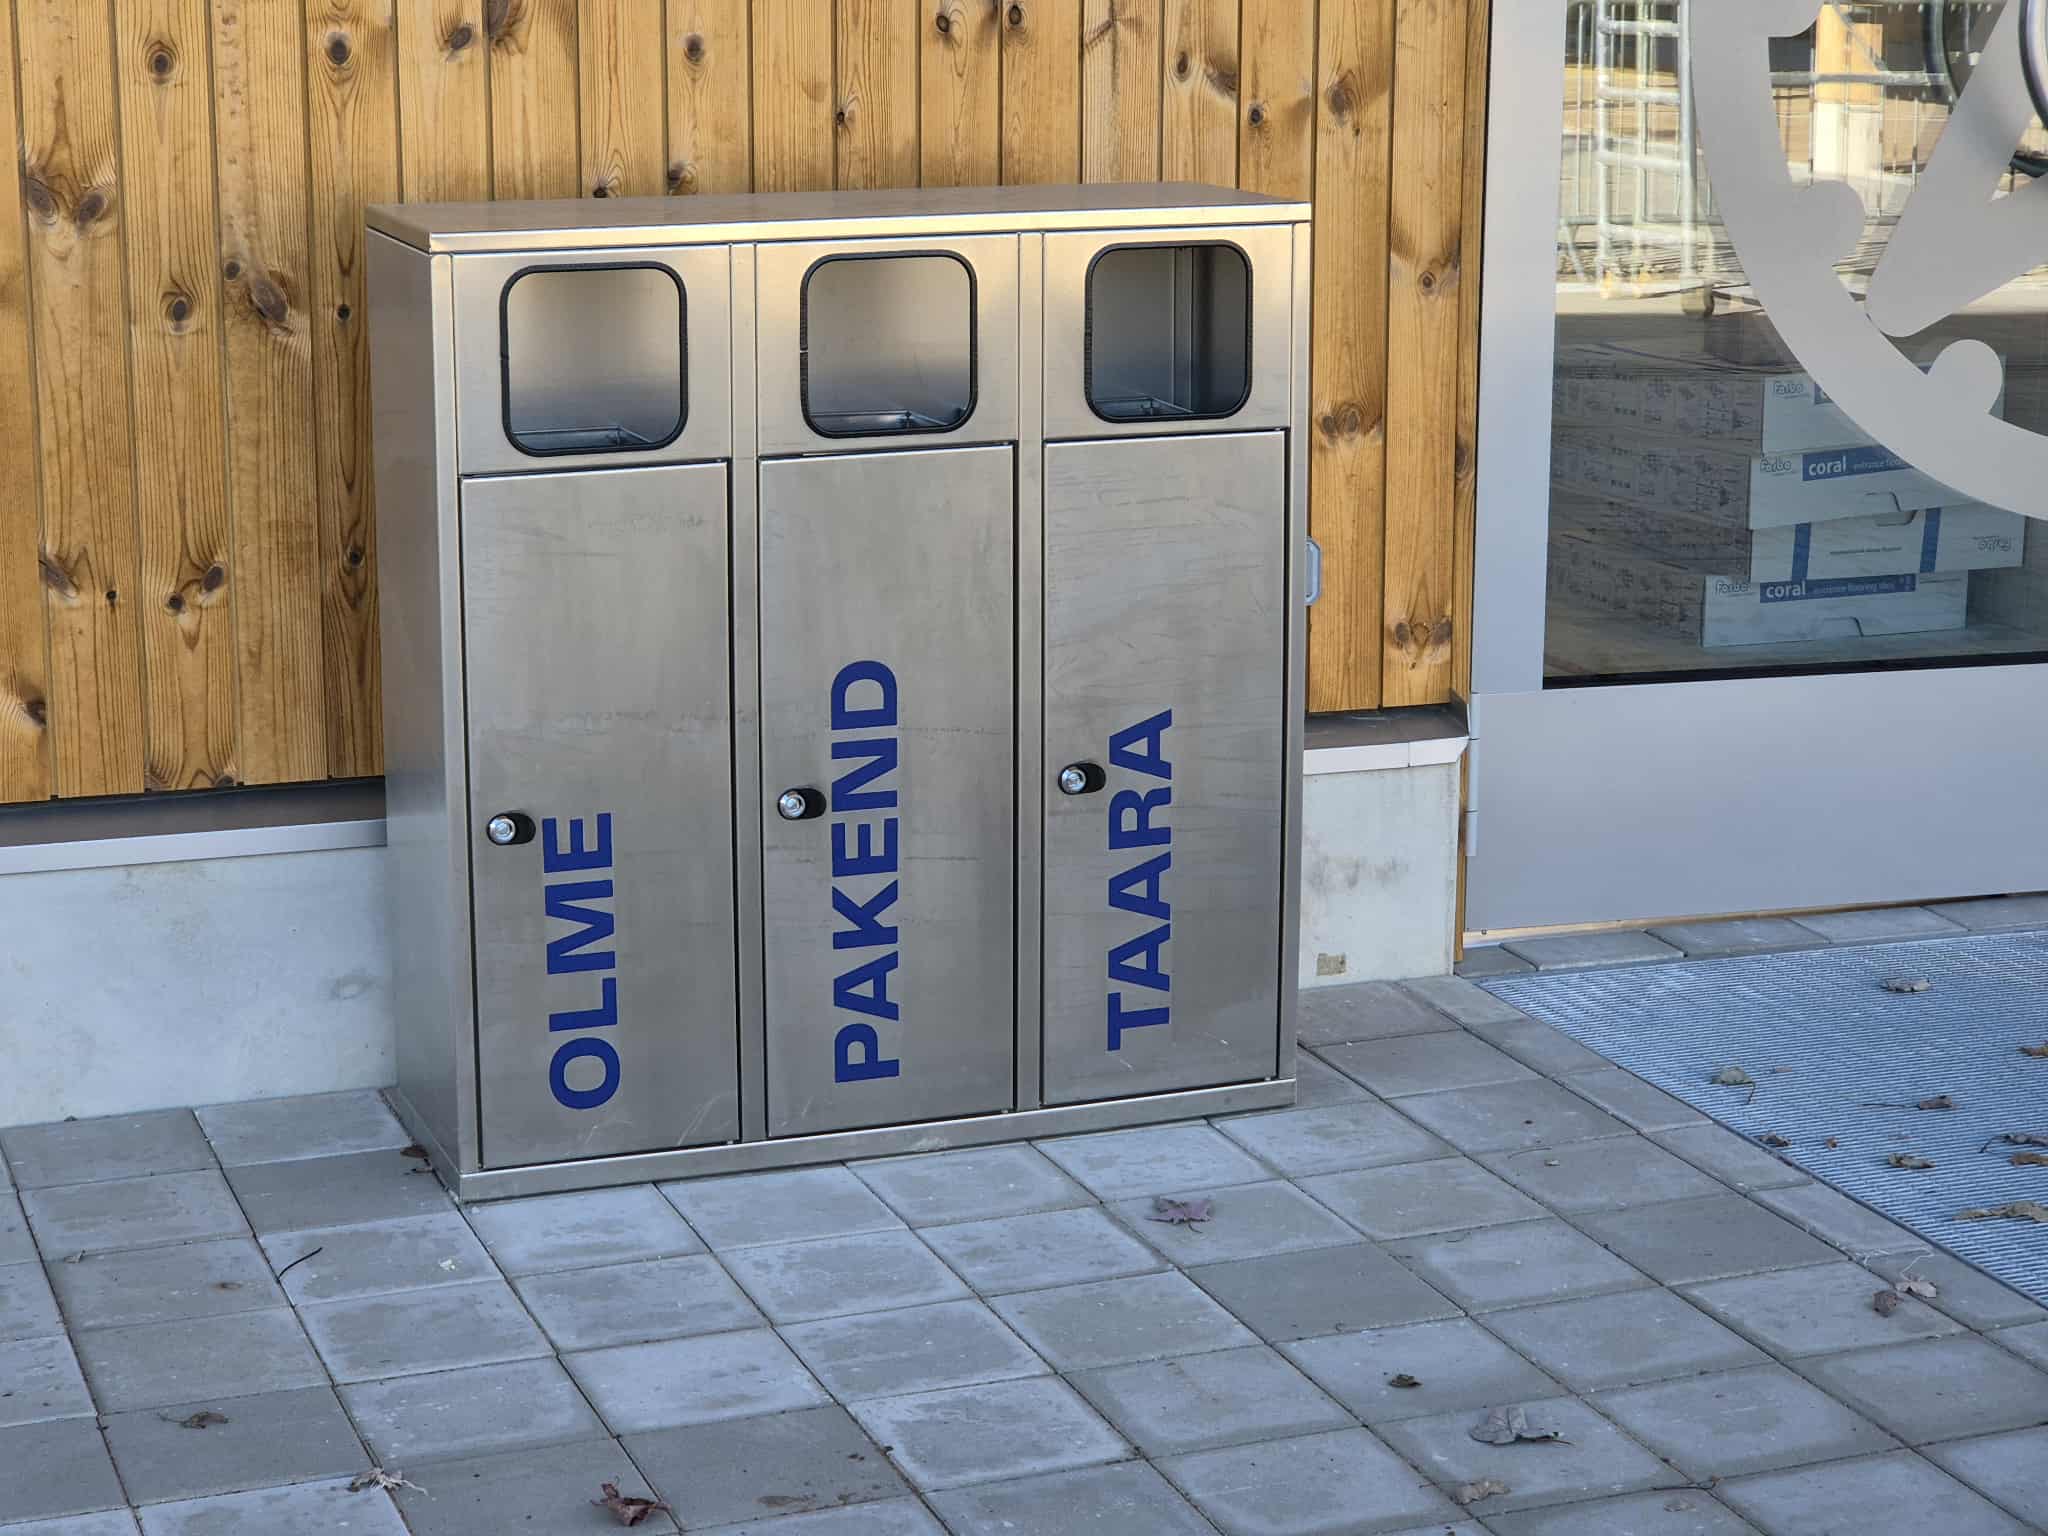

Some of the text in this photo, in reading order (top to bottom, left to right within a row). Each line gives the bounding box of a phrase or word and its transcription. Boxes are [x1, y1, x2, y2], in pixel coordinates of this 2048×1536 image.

[1766, 580, 1806, 599] coral
[1808, 455, 1847, 476] coral
[543, 812, 621, 1110] OLME
[831, 660, 900, 1083] PAKEND
[1107, 708, 1172, 1051] TAARA
